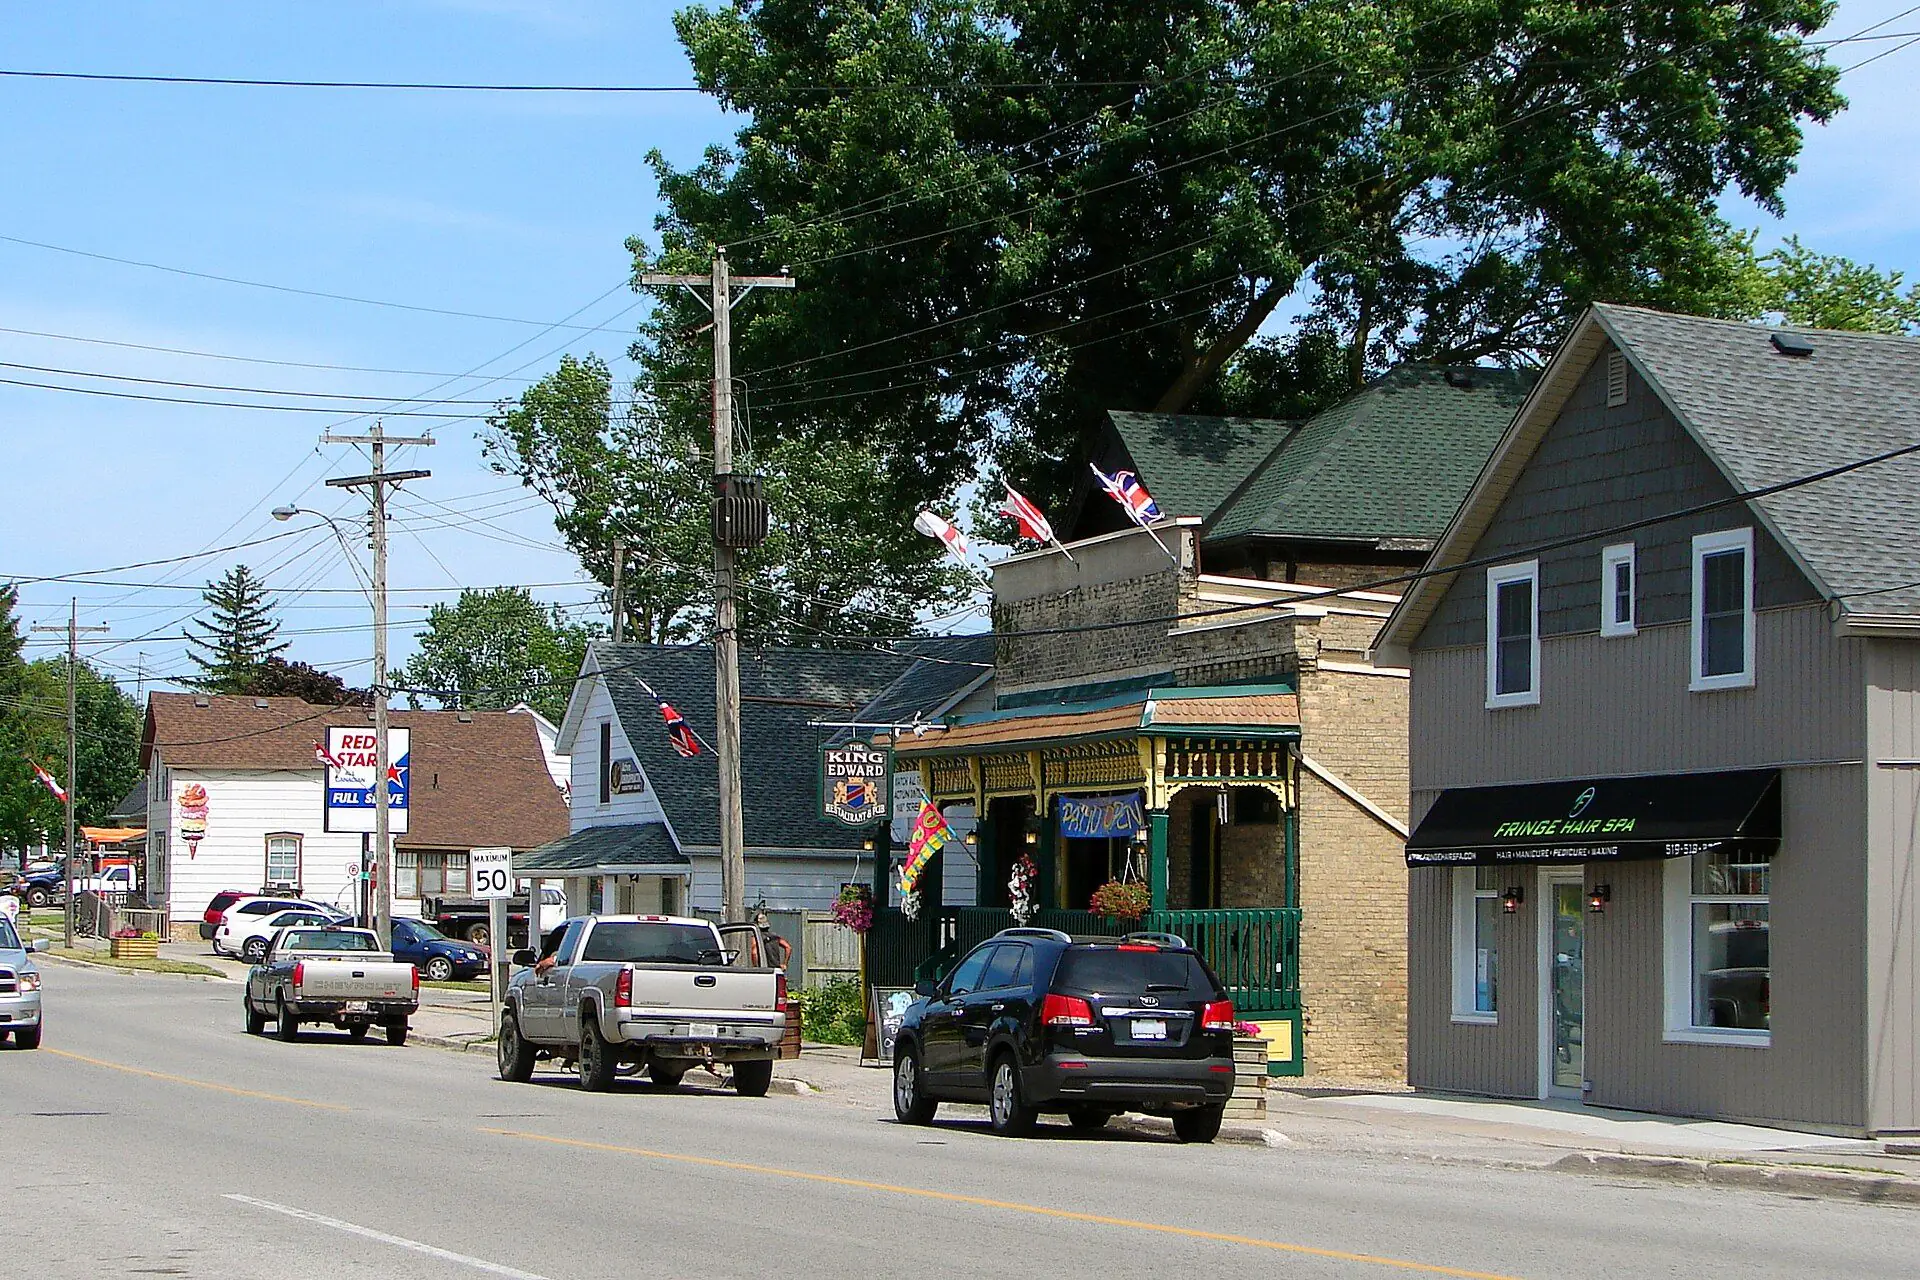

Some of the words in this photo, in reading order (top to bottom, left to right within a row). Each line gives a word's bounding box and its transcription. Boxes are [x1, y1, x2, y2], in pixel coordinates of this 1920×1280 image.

[342, 735, 377, 749] RED
[849, 744, 864, 752] THE
[337, 753, 377, 767] STAR
[828, 752, 884, 763] KING
[828, 764, 884, 777] EDWARD
[332, 792, 359, 804] FULL
[825, 803, 867, 823] RESTAURANT
[872, 804, 885, 817] PUB
[1103, 800, 1142, 832] OPEN
[1494, 819, 1562, 838] FRINGE
[1560, 819, 1602, 834] HAIR
[1602, 818, 1636, 832] SPA
[474, 854, 508, 862] MAXIMUM
[1496, 851, 1512, 860] HAIR
[1515, 849, 1549, 859] MANICURE
[1553, 848, 1587, 857] PEDICURE
[1591, 846, 1618, 856] WAXING
[477, 869, 507, 891] 50
[313, 980, 402, 991] CHEVROLET
